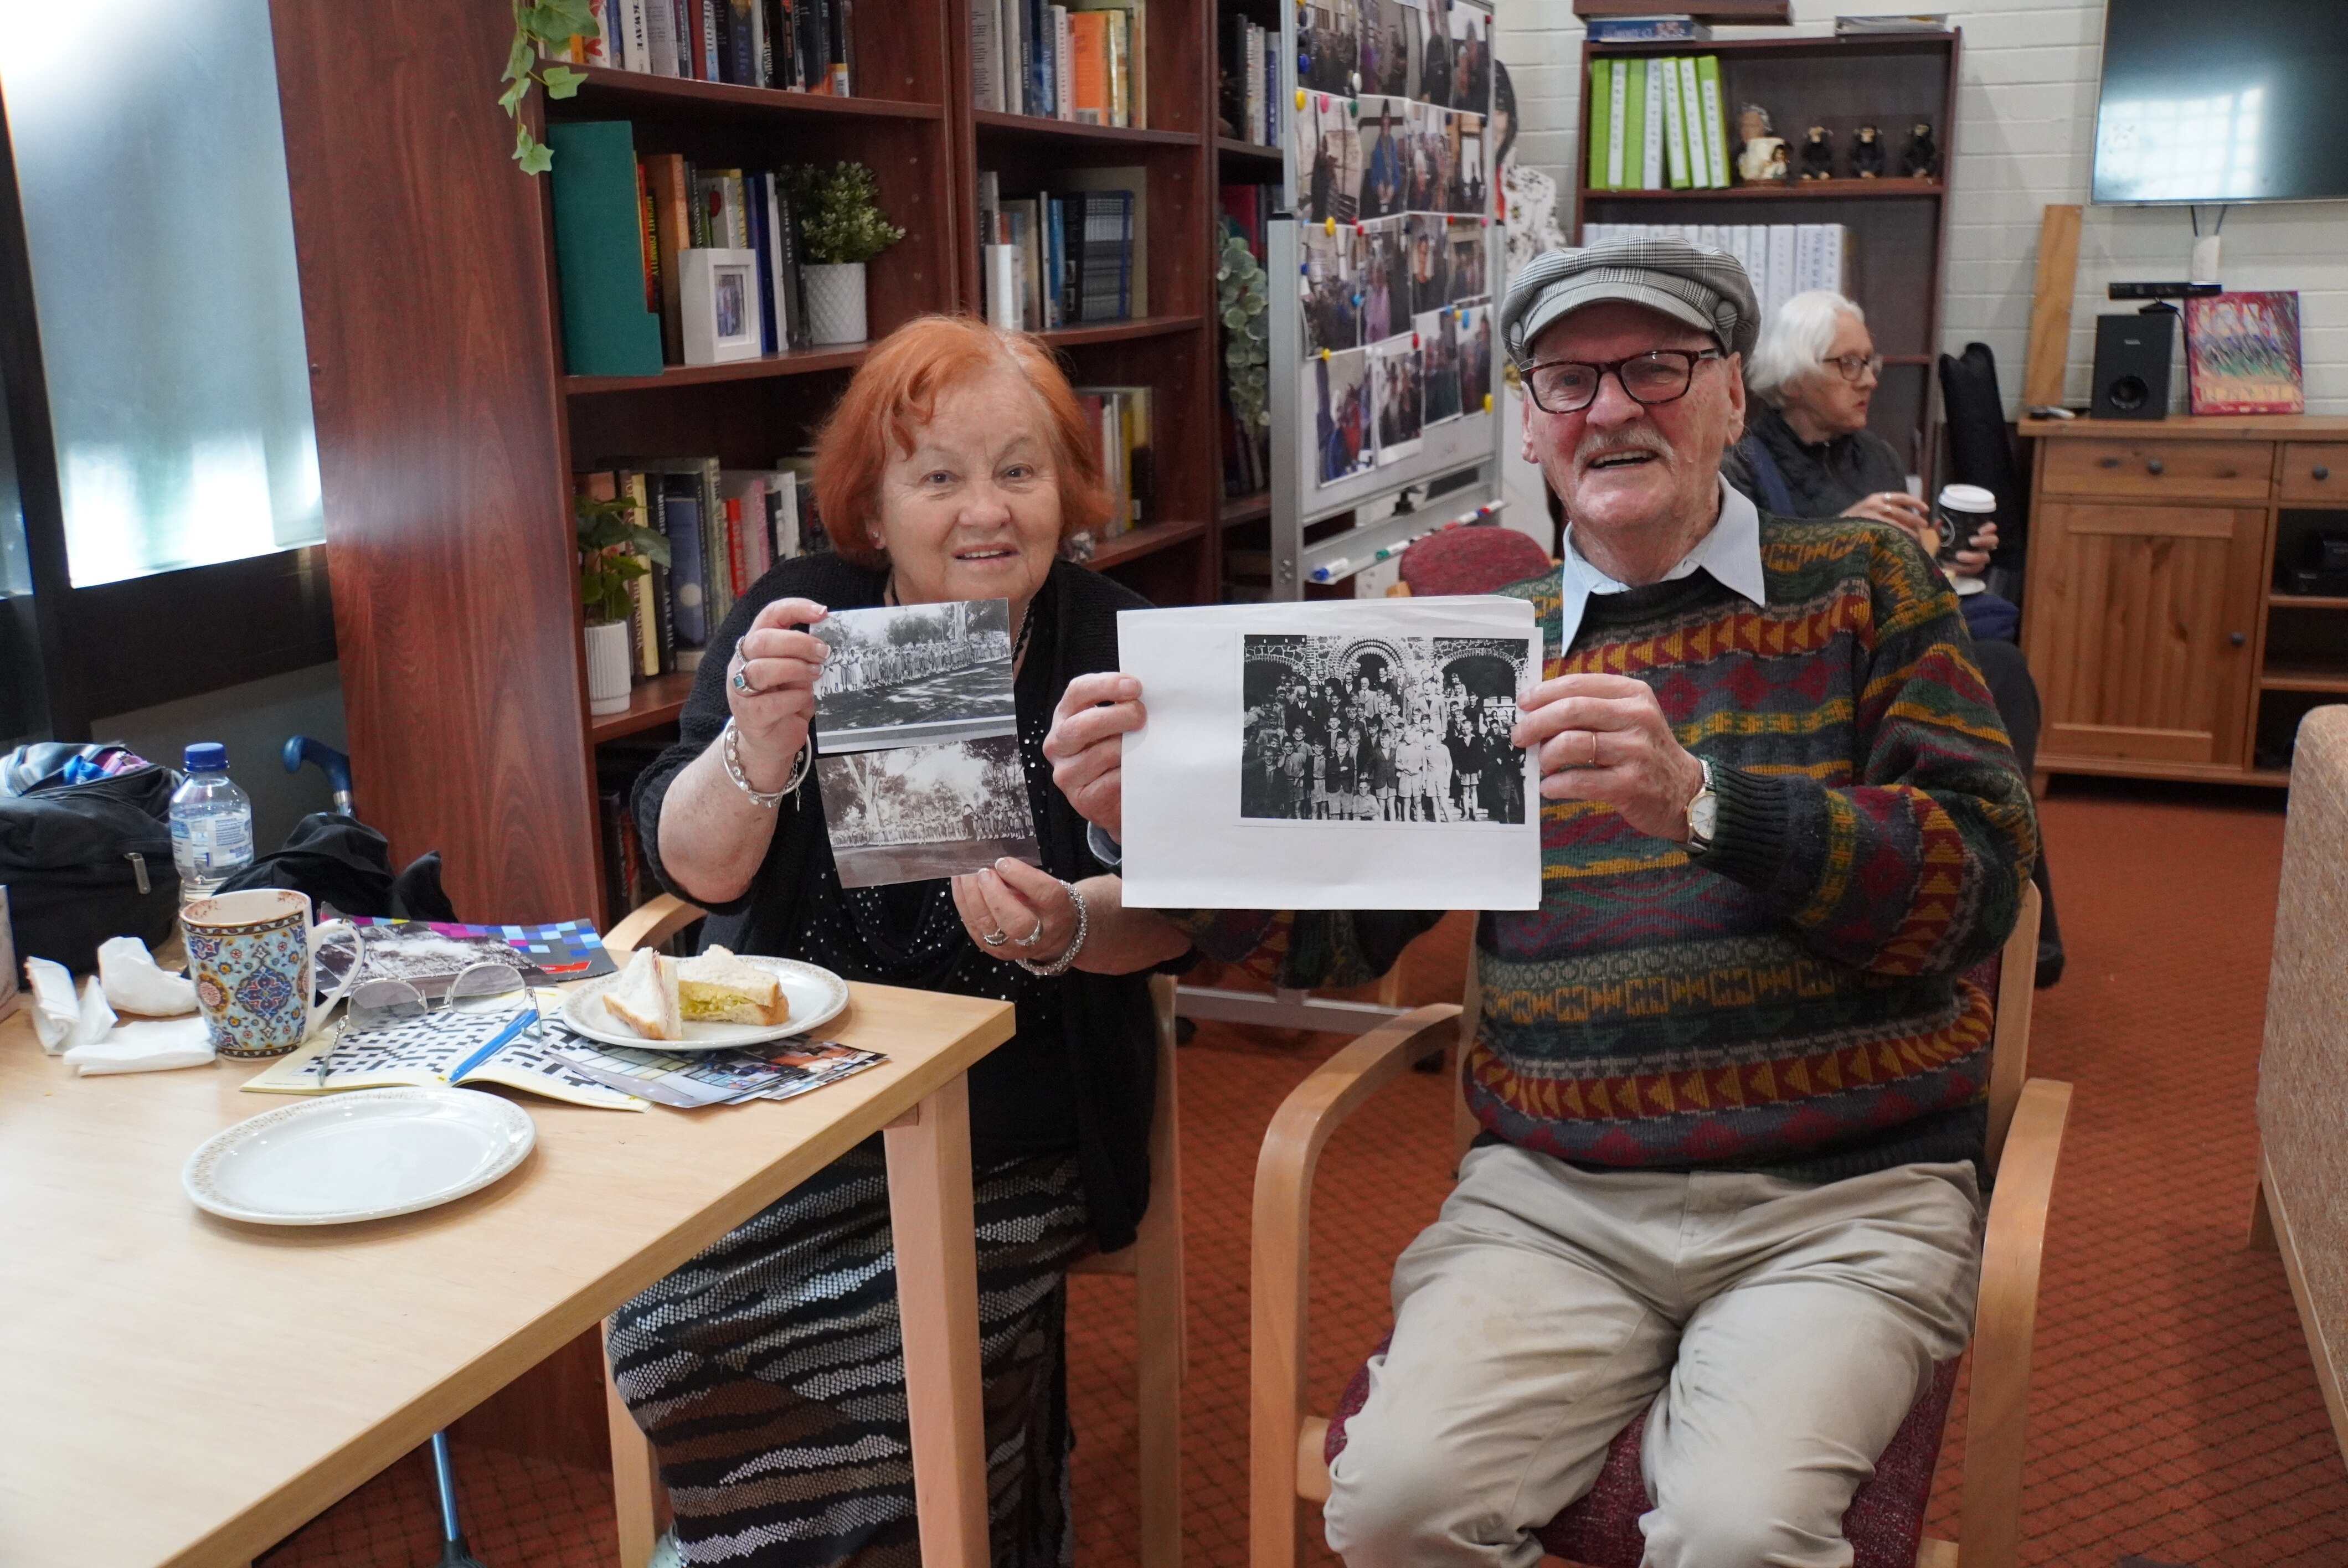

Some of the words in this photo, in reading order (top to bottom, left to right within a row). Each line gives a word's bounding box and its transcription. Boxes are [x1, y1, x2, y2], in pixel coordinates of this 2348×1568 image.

[646, 196, 656, 232] MICHAEL
[648, 235, 660, 276] CONNELLY
[633, 581, 641, 600] THE
[632, 602, 644, 651] PARTNER
